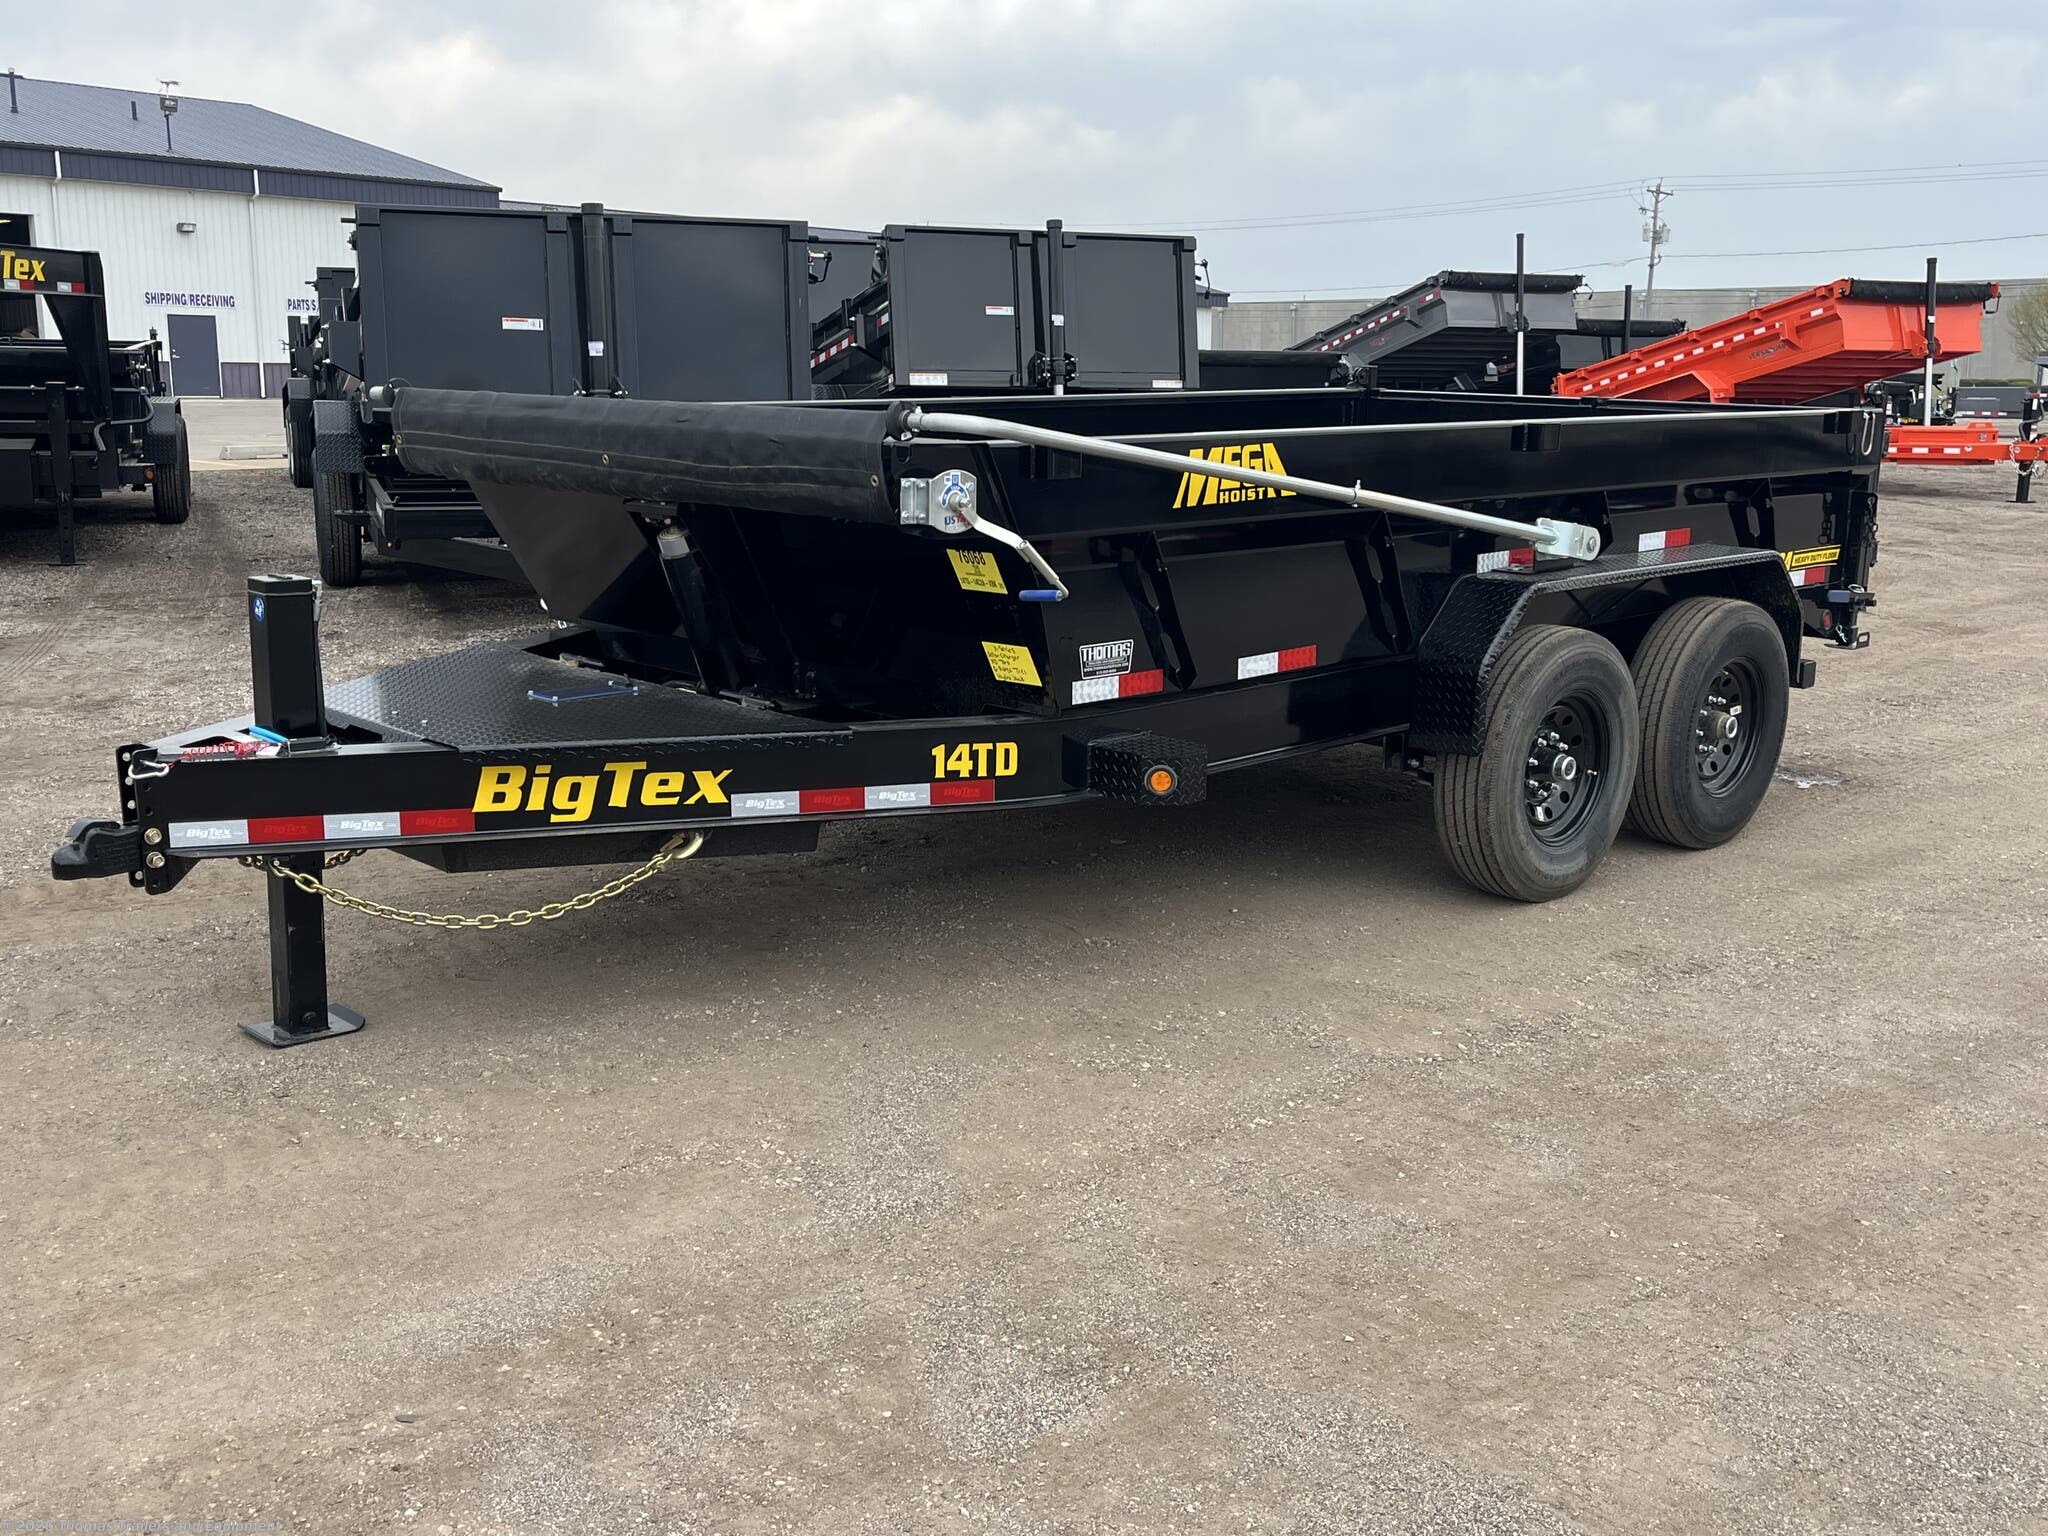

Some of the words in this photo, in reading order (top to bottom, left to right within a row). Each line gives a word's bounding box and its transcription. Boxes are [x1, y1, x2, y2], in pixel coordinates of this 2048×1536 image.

[1, 250, 46, 281] Tex
[1172, 442, 1297, 509] MEGA
[1219, 487, 1264, 504] HOIST
[1082, 643, 1131, 661] THOMAS
[931, 741, 1018, 779] 14TD
[471, 761, 733, 822] BigTex
